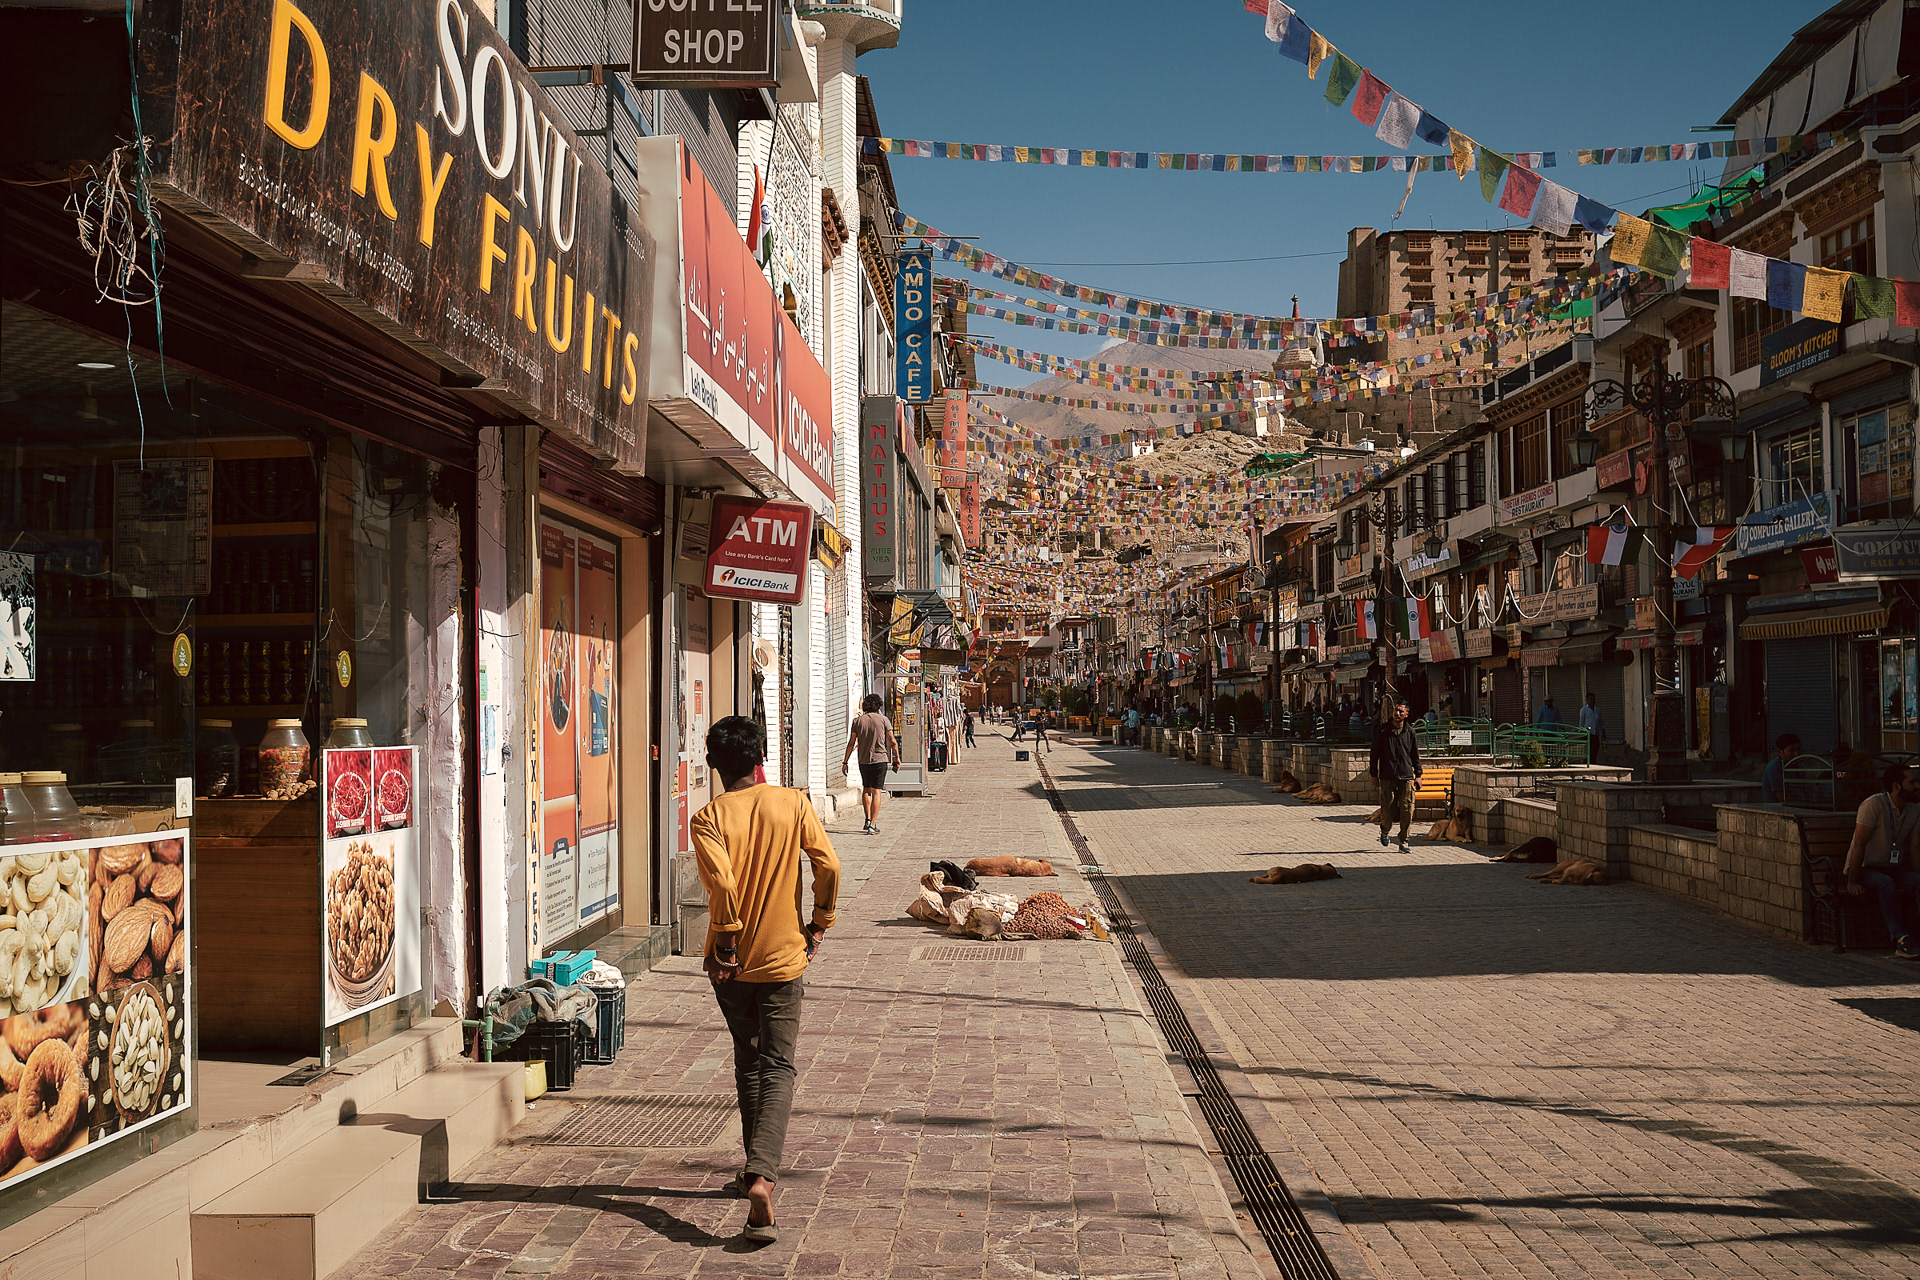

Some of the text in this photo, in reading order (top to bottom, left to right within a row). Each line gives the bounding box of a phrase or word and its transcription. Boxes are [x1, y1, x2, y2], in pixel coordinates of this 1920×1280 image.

[664, 29, 744, 64] SHOP
[264, 0, 453, 249] DRY
[434, 0, 583, 253] SONU
[479, 192, 639, 405] FRUITS
[905, 255, 923, 400] AMDO CAFE
[1770, 327, 1838, 370] BLOOM'S KITCHEN
[1776, 363, 1796, 379] DELIGHT
[1802, 353, 1818, 368] EVERY
[1818, 349, 1830, 362] BITE
[690, 367, 719, 416] Leh Branch
[788, 389, 813, 466] ICICI
[812, 420, 834, 489] Bank
[949, 404, 961, 471] HIMALYAN
[870, 424, 887, 537] NATHUS
[944, 475, 963, 484] CAFE
[1538, 484, 1554, 498] CORNER
[1511, 498, 1545, 517] RESTAURANT
[725, 515, 798, 547] ATM
[1749, 510, 1815, 542] COMPUTER GALLERY
[1870, 559, 1894, 568] SALE
[1897, 558, 1905, 567] &
[733, 576, 790, 591] ICICI Bank
[1586, 599, 1597, 608] HOUSE
